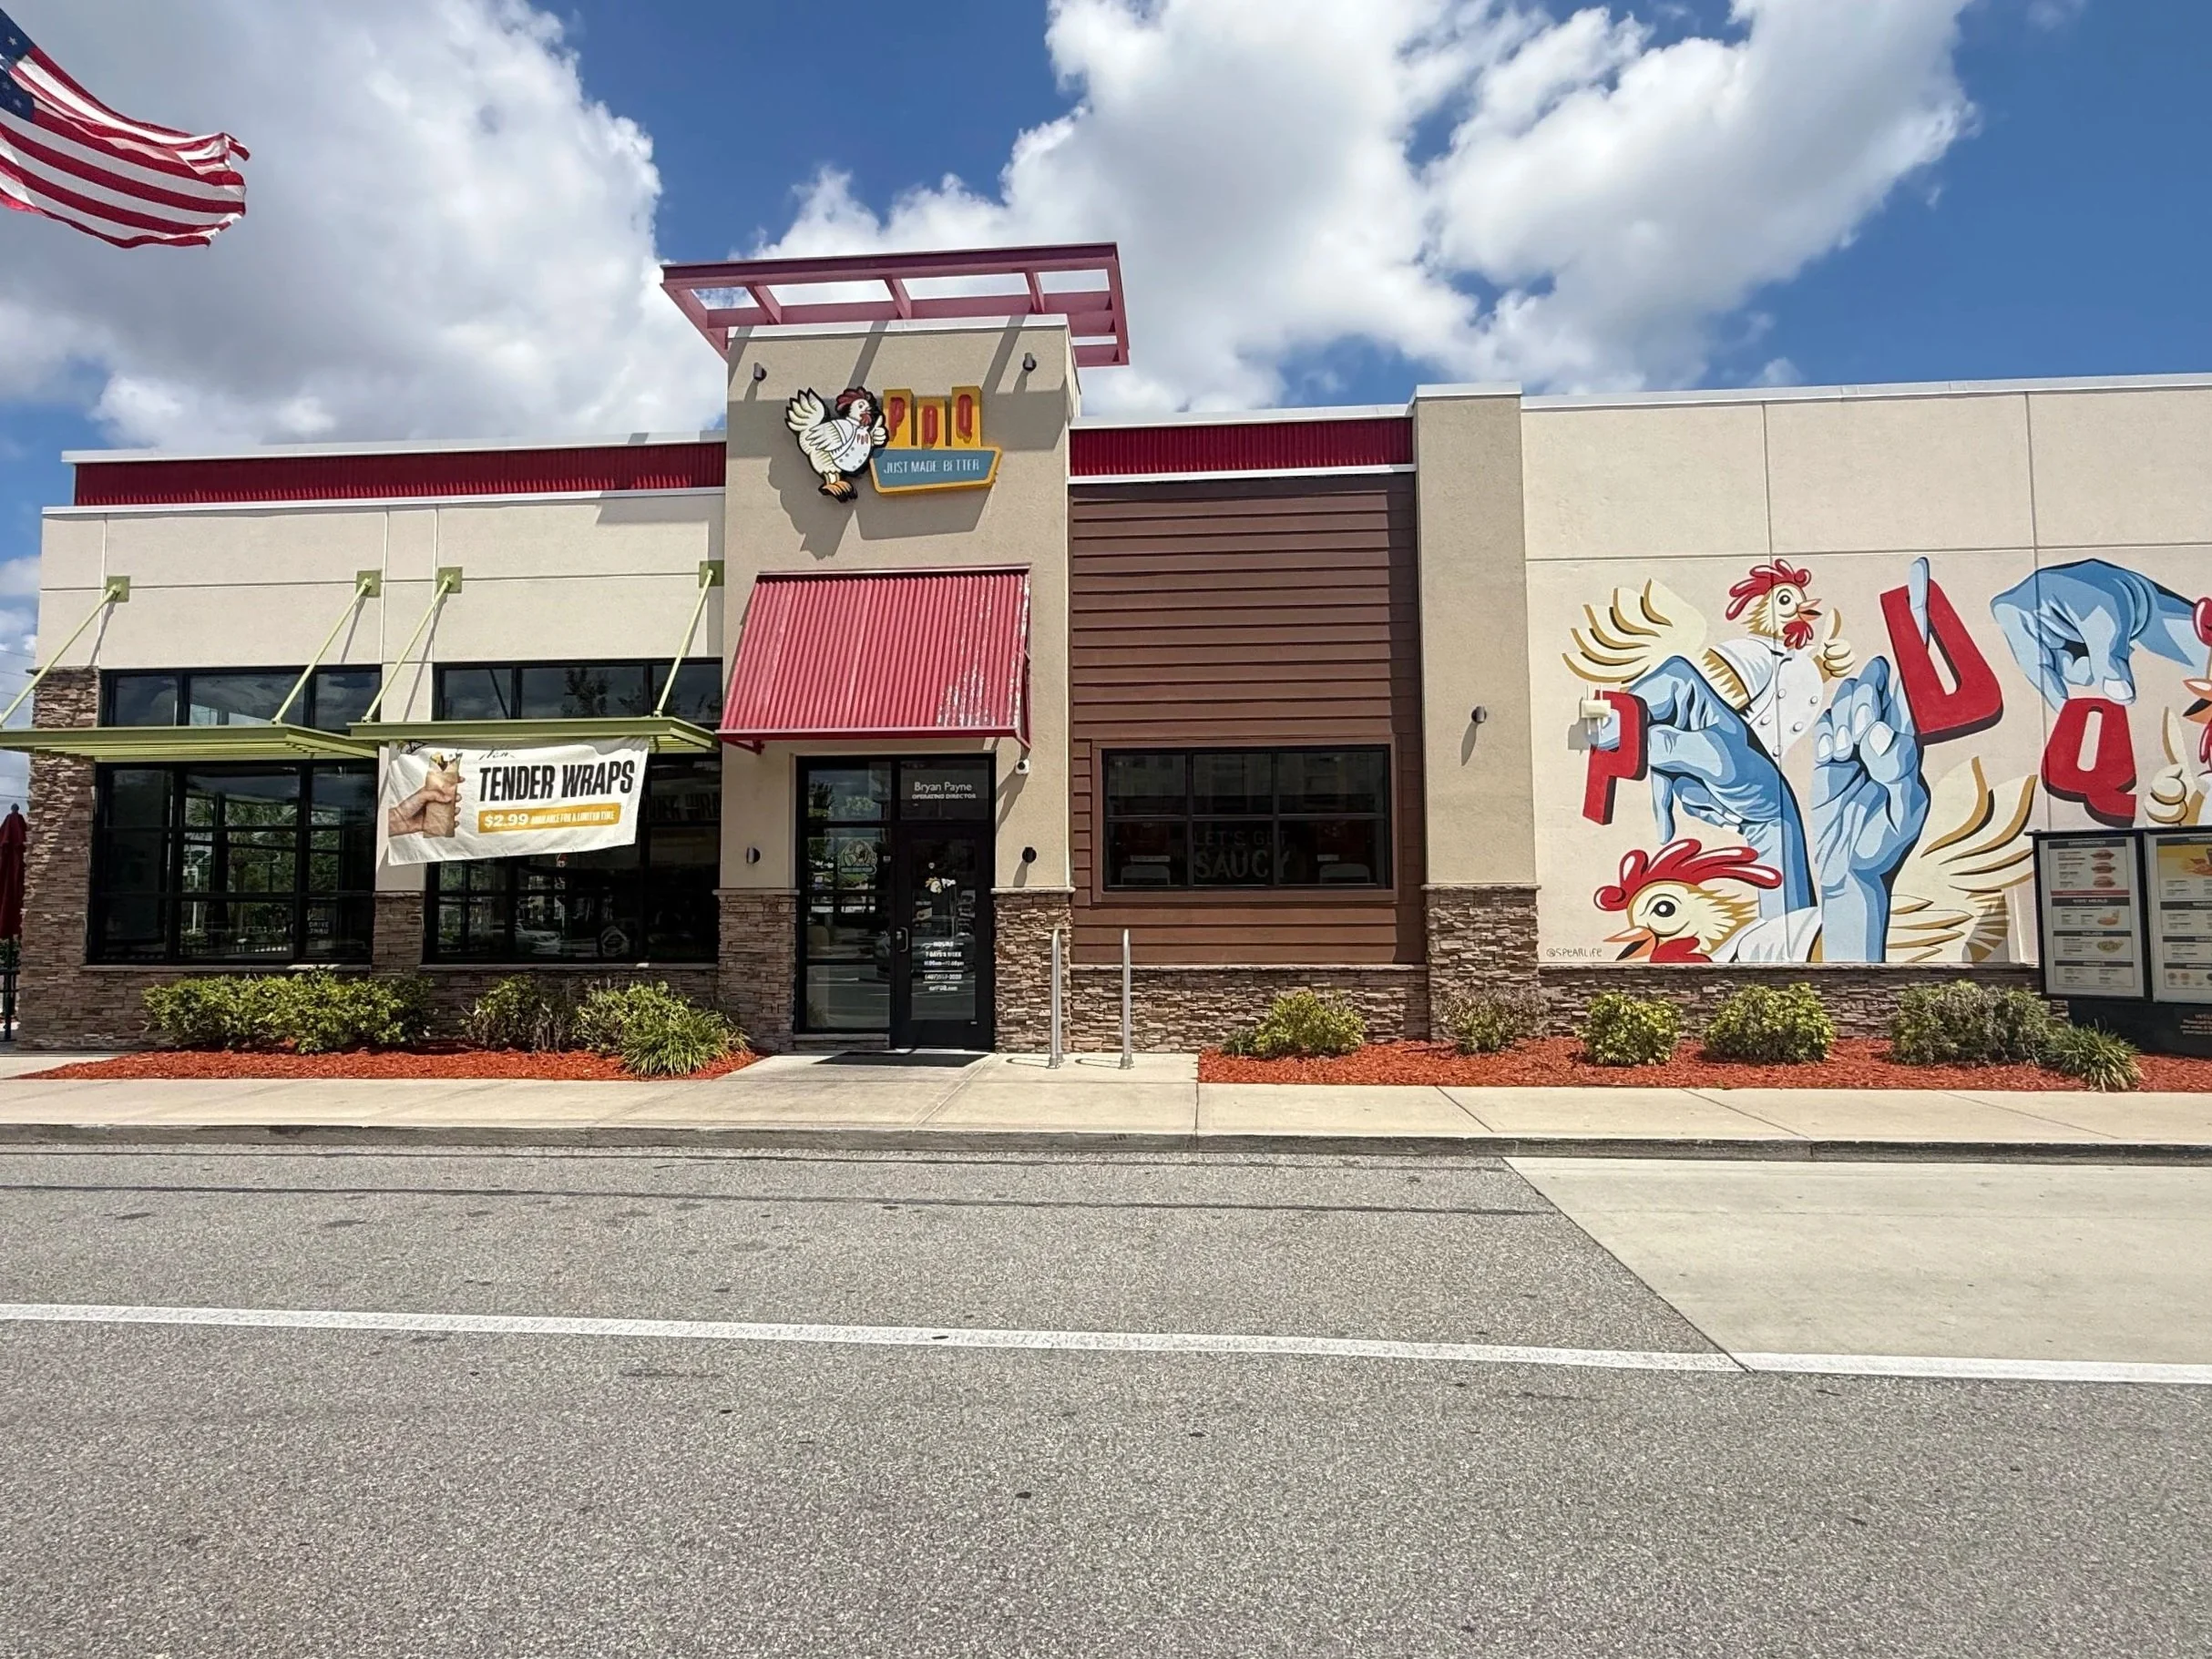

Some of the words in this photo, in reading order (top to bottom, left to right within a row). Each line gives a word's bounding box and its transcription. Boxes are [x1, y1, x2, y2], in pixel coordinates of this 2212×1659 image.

[884, 461, 909, 474] JUST
[911, 459, 937, 474] MADE
[943, 458, 980, 473] BETTER
[479, 764, 556, 803] TENDER
[561, 760, 635, 798] WRAPS
[914, 781, 942, 794] Bryan
[944, 781, 973, 794] Payne
[484, 813, 529, 829] $2.99
[1193, 830, 1246, 846] LET'S
